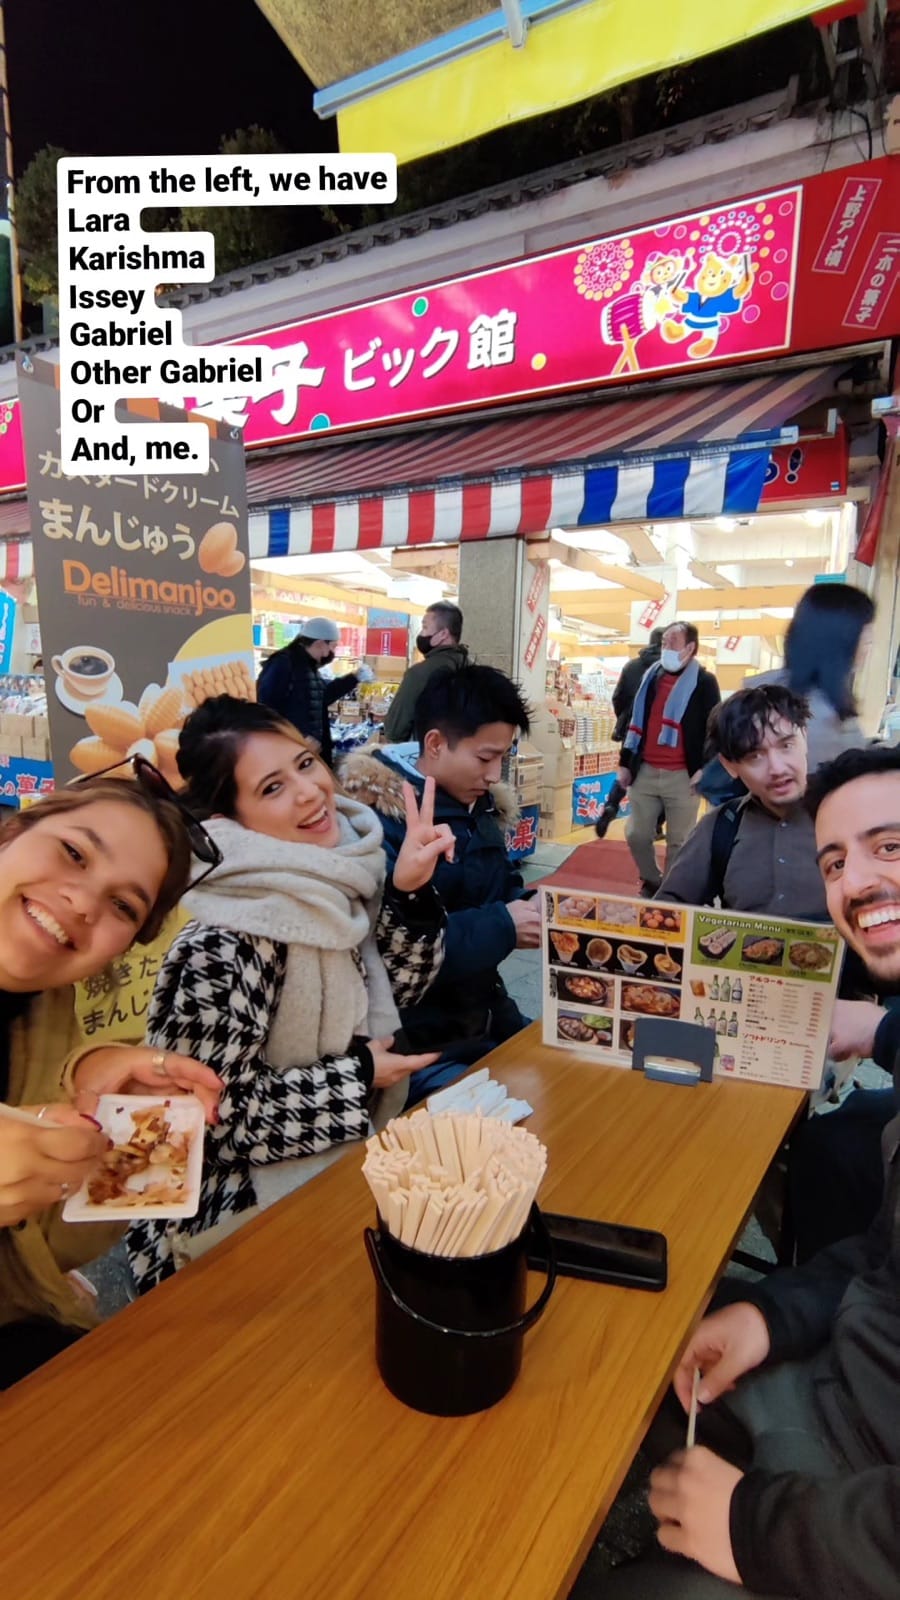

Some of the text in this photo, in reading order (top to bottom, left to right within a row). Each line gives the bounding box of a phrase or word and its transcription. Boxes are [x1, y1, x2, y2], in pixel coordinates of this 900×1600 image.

[344, 308, 517, 391] ビック館
[39, 498, 195, 561] まんじゅう
[62, 559, 236, 617] Delimanjoo
[77, 593, 97, 608] fun
[698, 914, 751, 930] Vegetarian
[754, 922, 781, 933] Menu
